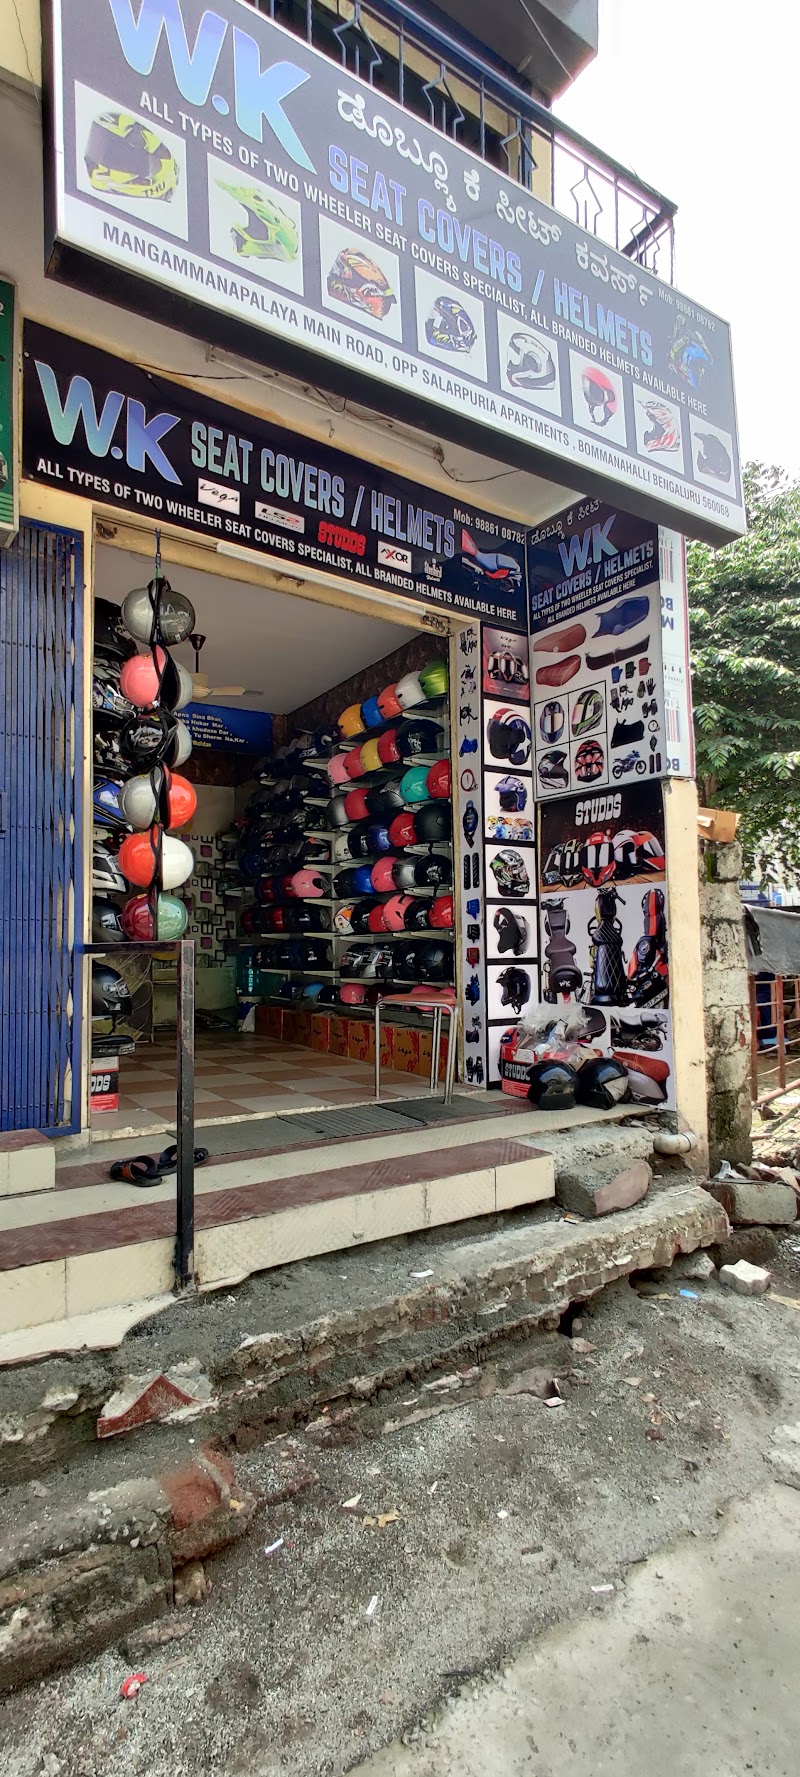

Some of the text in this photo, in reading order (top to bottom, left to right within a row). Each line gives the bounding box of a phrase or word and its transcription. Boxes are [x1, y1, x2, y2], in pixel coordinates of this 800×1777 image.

[109, 0, 318, 175] W.K
[464, 169, 481, 202] ಕೆ
[496, 190, 562, 246] ಸೀಟ್
[139, 91, 707, 416] ALL TYPES OF TWO WHEELER SEAT COVERS SPECIALIST, ALL BRANDED HELMETS AVAILABLE HERE
[328, 144, 407, 227] SEAT
[418, 198, 522, 293] COVERS
[554, 277, 653, 367] HELMETS
[102, 221, 298, 327] MANGAMMANAPALAYA
[303, 313, 343, 349] MAIN
[345, 329, 388, 370] ROAD,
[392, 348, 418, 379] OPP
[422, 361, 497, 415] SALARPURIA
[500, 395, 570, 447] APARTMENTS
[578, 431, 651, 483] BOMMANAHALLI
[652, 463, 701, 505] BENGALURU
[702, 489, 730, 518] 560068
[34, 359, 183, 486] W.K
[191, 421, 253, 484] SEAT
[260, 447, 345, 518] COVERS
[370, 490, 455, 558] HELMETS
[37, 457, 64, 480] ALL
[67, 466, 110, 495] TYPES
[114, 481, 131, 499] OF
[134, 488, 163, 511] TWO
[166, 499, 222, 530] WHEELER
[225, 518, 252, 539] SEAT
[254, 528, 295, 553] COVERS
[297, 542, 353, 574] SPECIALIST,
[355, 562, 372, 579] ALL
[374, 568, 414, 592] BRANDED
[415, 581, 452, 604] HELMETS
[453, 593, 495, 616] AVAILABLE
[496, 606, 517, 621] HERE
[318, 521, 366, 557] STUDDS
[381, 548, 409, 564] AXOR
[453, 508, 526, 546] Mob: 98861 08782
[558, 514, 619, 577] W.K
[532, 587, 554, 611] SEAT
[555, 570, 592, 600] COVERS
[604, 540, 654, 578] HELMETS
[533, 612, 541, 620] ALL
[541, 606, 554, 617] TYPES
[561, 599, 571, 609] TWO
[570, 589, 592, 605] WHEELER
[592, 583, 604, 594] SEAT
[604, 574, 623, 589] COVERS
[547, 579, 636, 624] ALL BRANDED HELMETS AVAILABLE HERE
[575, 793, 622, 826] STUDDS
